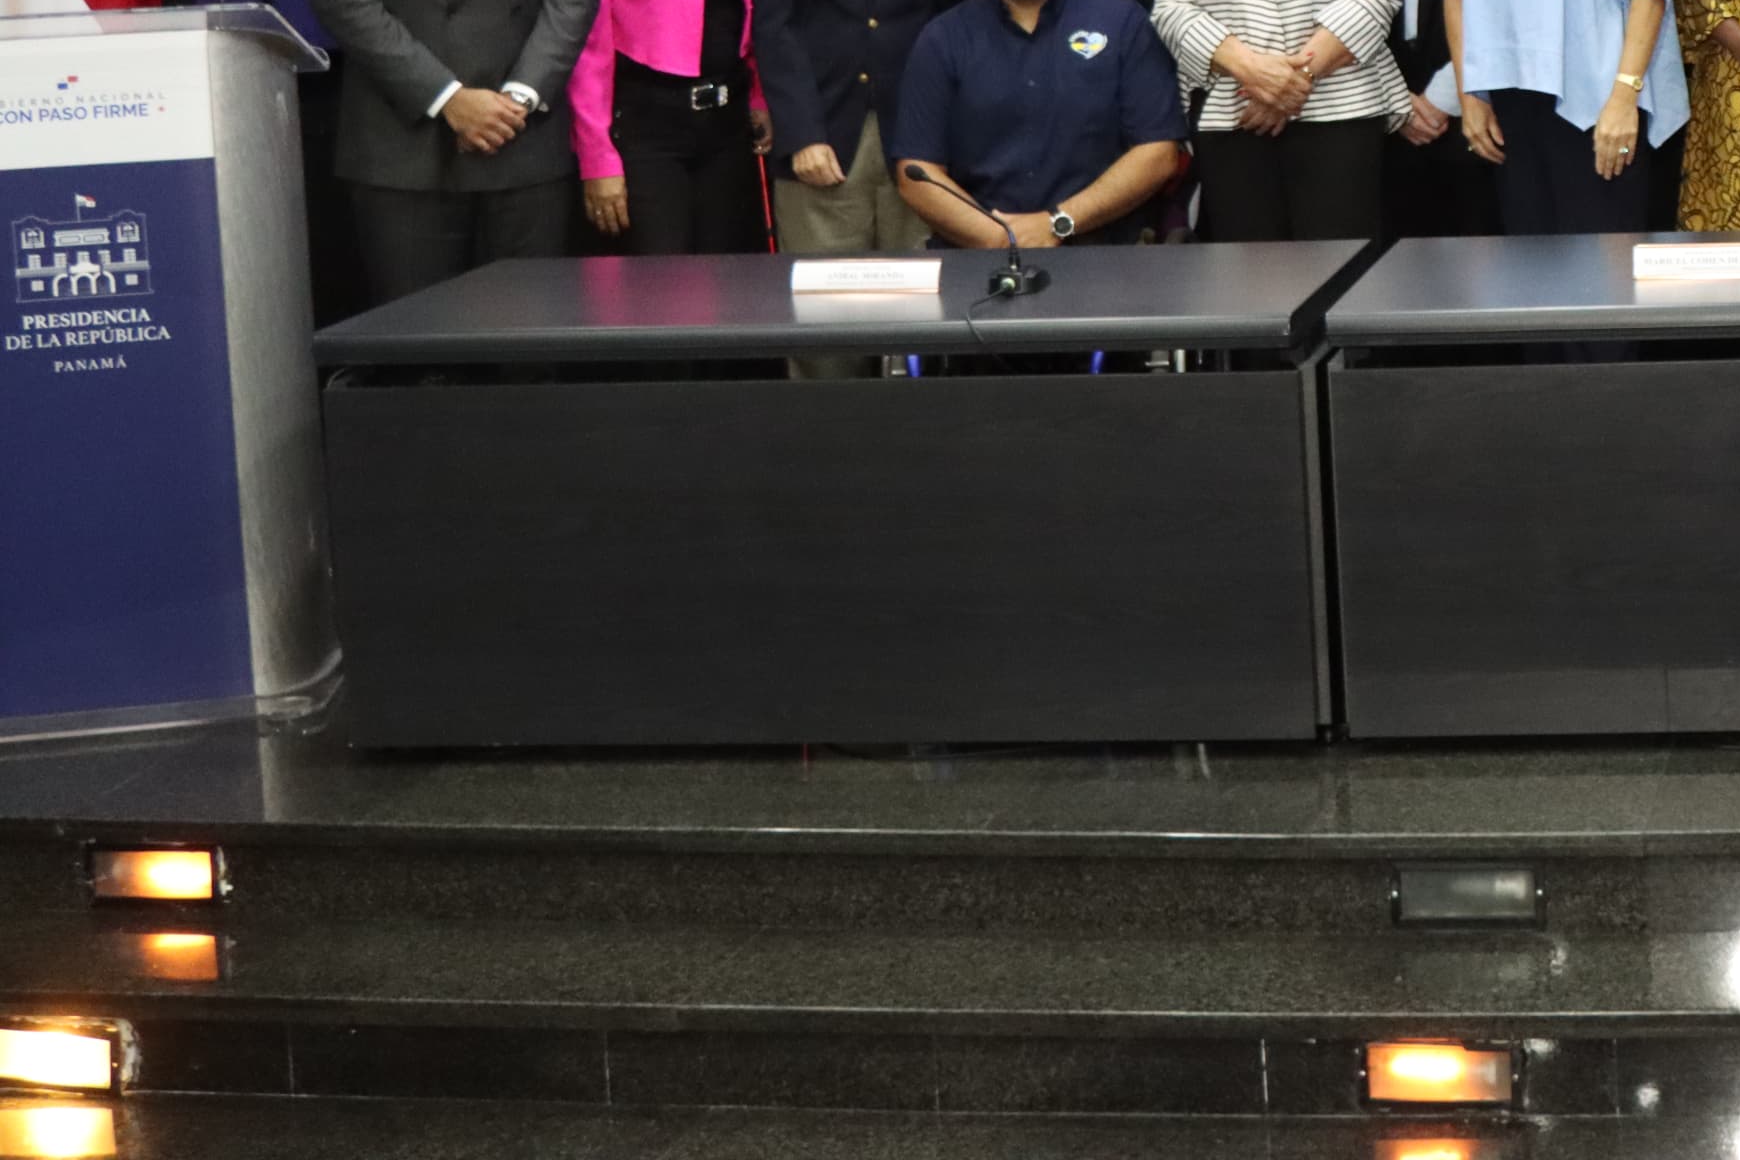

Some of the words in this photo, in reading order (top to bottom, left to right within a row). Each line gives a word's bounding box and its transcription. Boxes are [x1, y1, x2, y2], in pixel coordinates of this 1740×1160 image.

[38, 106, 88, 123] PASO
[93, 103, 149, 119] FIRME
[22, 308, 152, 331] PRESIDENCIA
[5, 335, 33, 351] DE
[36, 334, 62, 348] LA
[65, 326, 171, 346] REPÚBLICA
[54, 354, 128, 373] PANAMÁ
